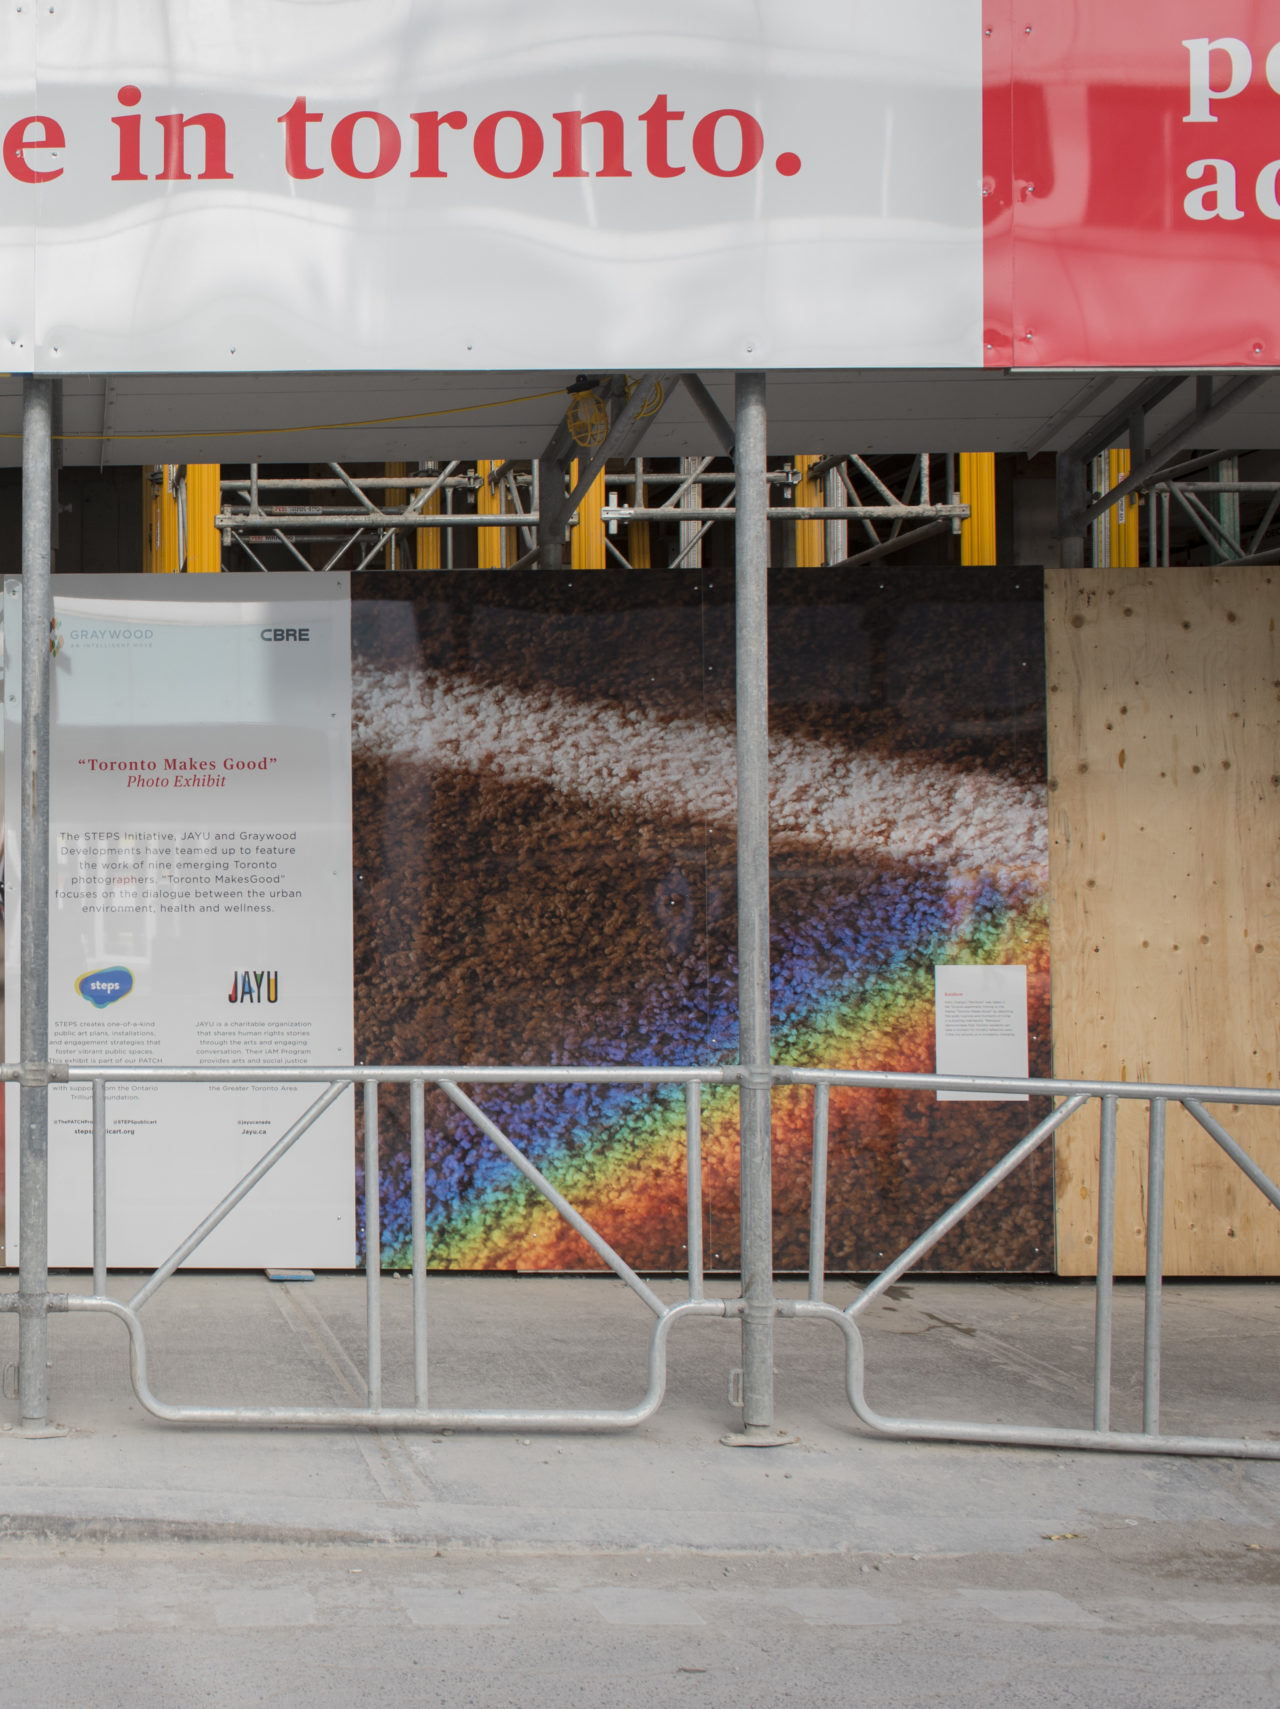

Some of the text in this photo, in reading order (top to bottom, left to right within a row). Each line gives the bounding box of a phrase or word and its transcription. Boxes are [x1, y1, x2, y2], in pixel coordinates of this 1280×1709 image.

[1182, 37, 1280, 123] p
[111, 84, 234, 182] in
[278, 93, 803, 181] toronto.
[70, 629, 154, 640] GRAYWOOD
[260, 628, 310, 642] CBRE
[78, 758, 277, 771] “Toronto Makes Good”
[127, 775, 226, 788] Photo Exhibit
[60, 832, 296, 842] The STEPS Initiative, JAYU and Graywood
[61, 846, 296, 857] Developments have teamed up to feature
[80, 861, 277, 871] the work of nine emerging Toronto
[55, 890, 97, 898] focuses
[120, 890, 137, 898] the
[142, 890, 190, 900] dialogue
[195, 890, 243, 898] between
[247, 890, 265, 898] the
[270, 890, 302, 898] urban
[82, 904, 274, 913] environment, health and wellness.
[90, 979, 120, 994] steps
[228, 970, 279, 1004] JAYU
